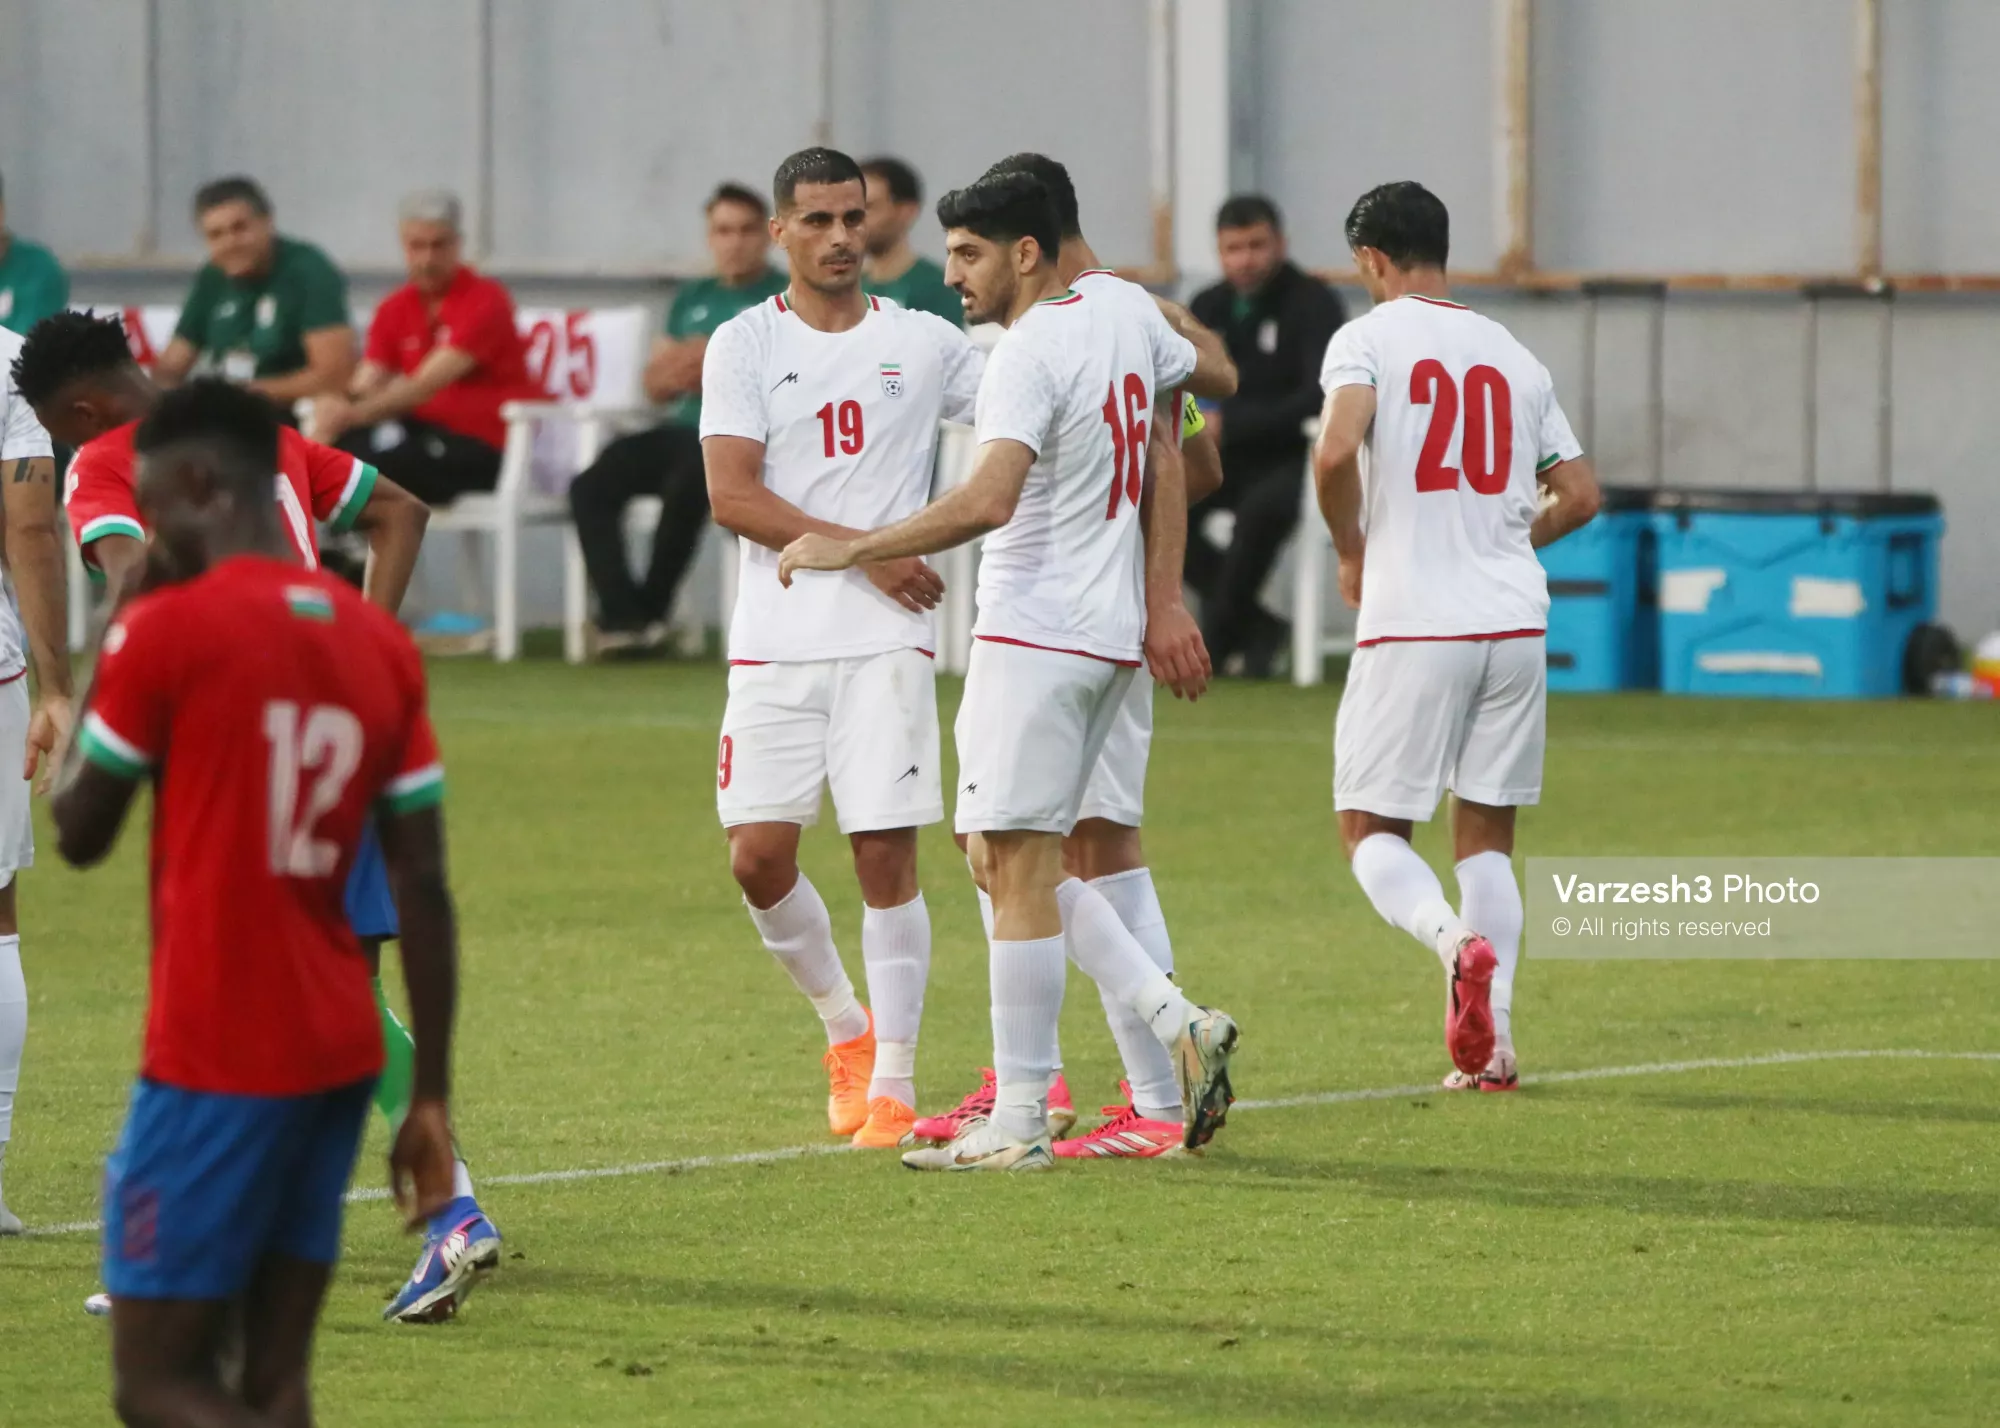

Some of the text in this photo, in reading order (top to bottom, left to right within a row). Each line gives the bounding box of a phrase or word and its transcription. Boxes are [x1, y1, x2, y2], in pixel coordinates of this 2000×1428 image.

[528, 311, 597, 402] 25
[816, 399, 865, 458] 19
[1102, 373, 1148, 521] 16
[1409, 358, 1513, 495] 20
[264, 700, 365, 877] 12
